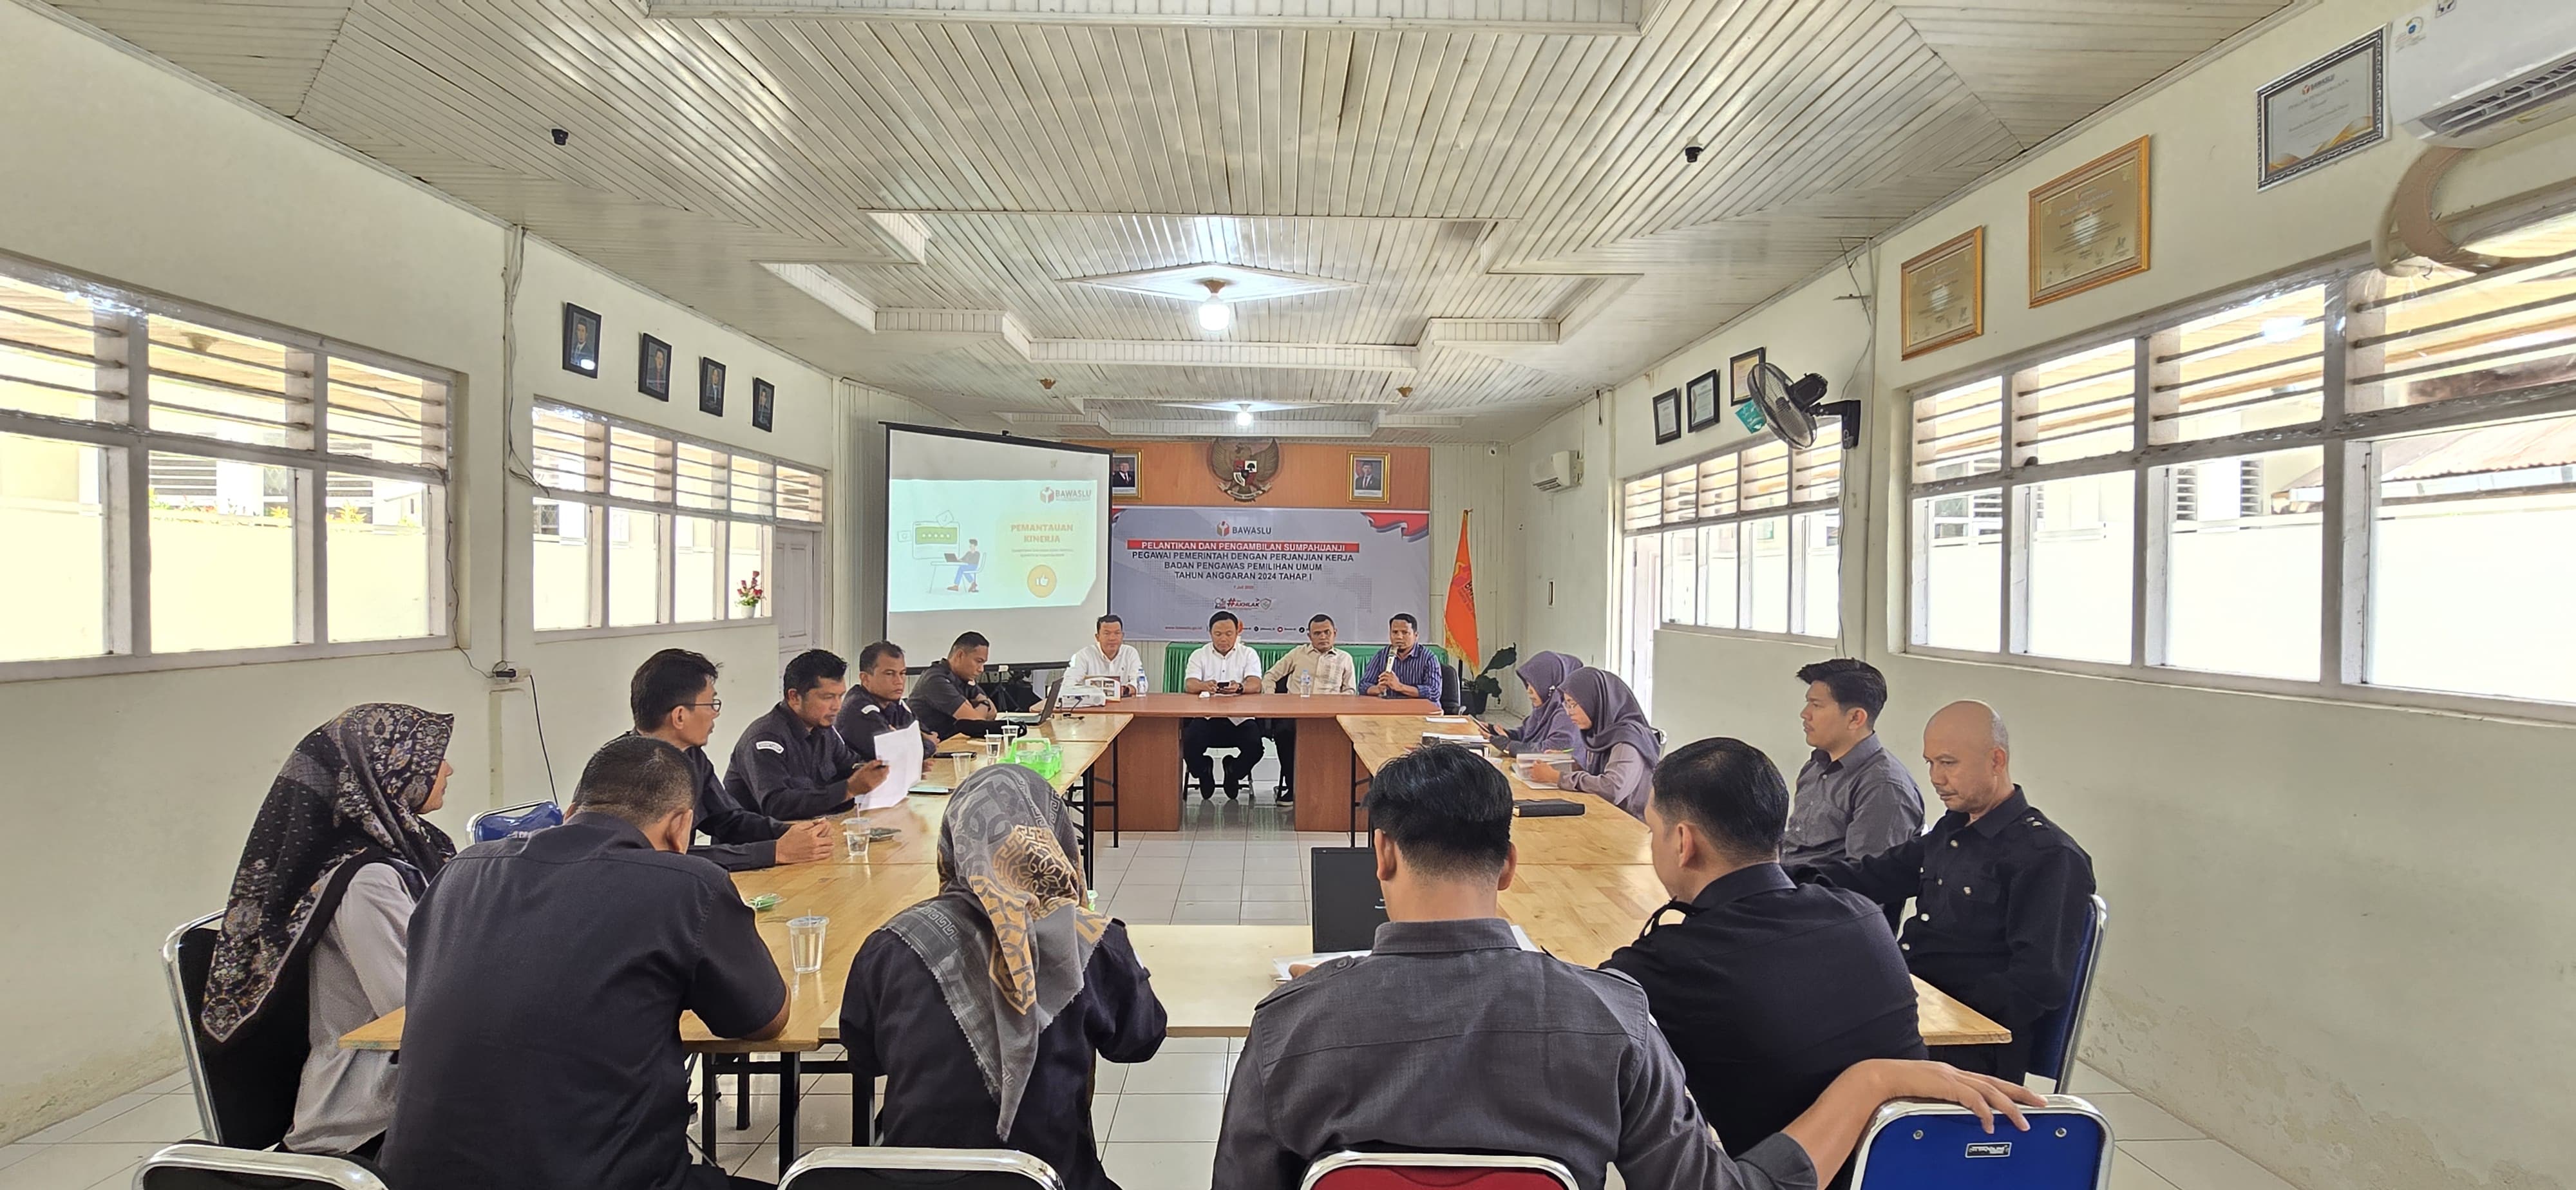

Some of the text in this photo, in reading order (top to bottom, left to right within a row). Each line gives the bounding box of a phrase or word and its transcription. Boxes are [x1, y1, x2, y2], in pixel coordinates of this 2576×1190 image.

[1232, 526, 1272, 534] BAWASLU
[1218, 542, 1282, 551] PENGAMBILAN
[1132, 551, 1171, 560] PEGAWAI
